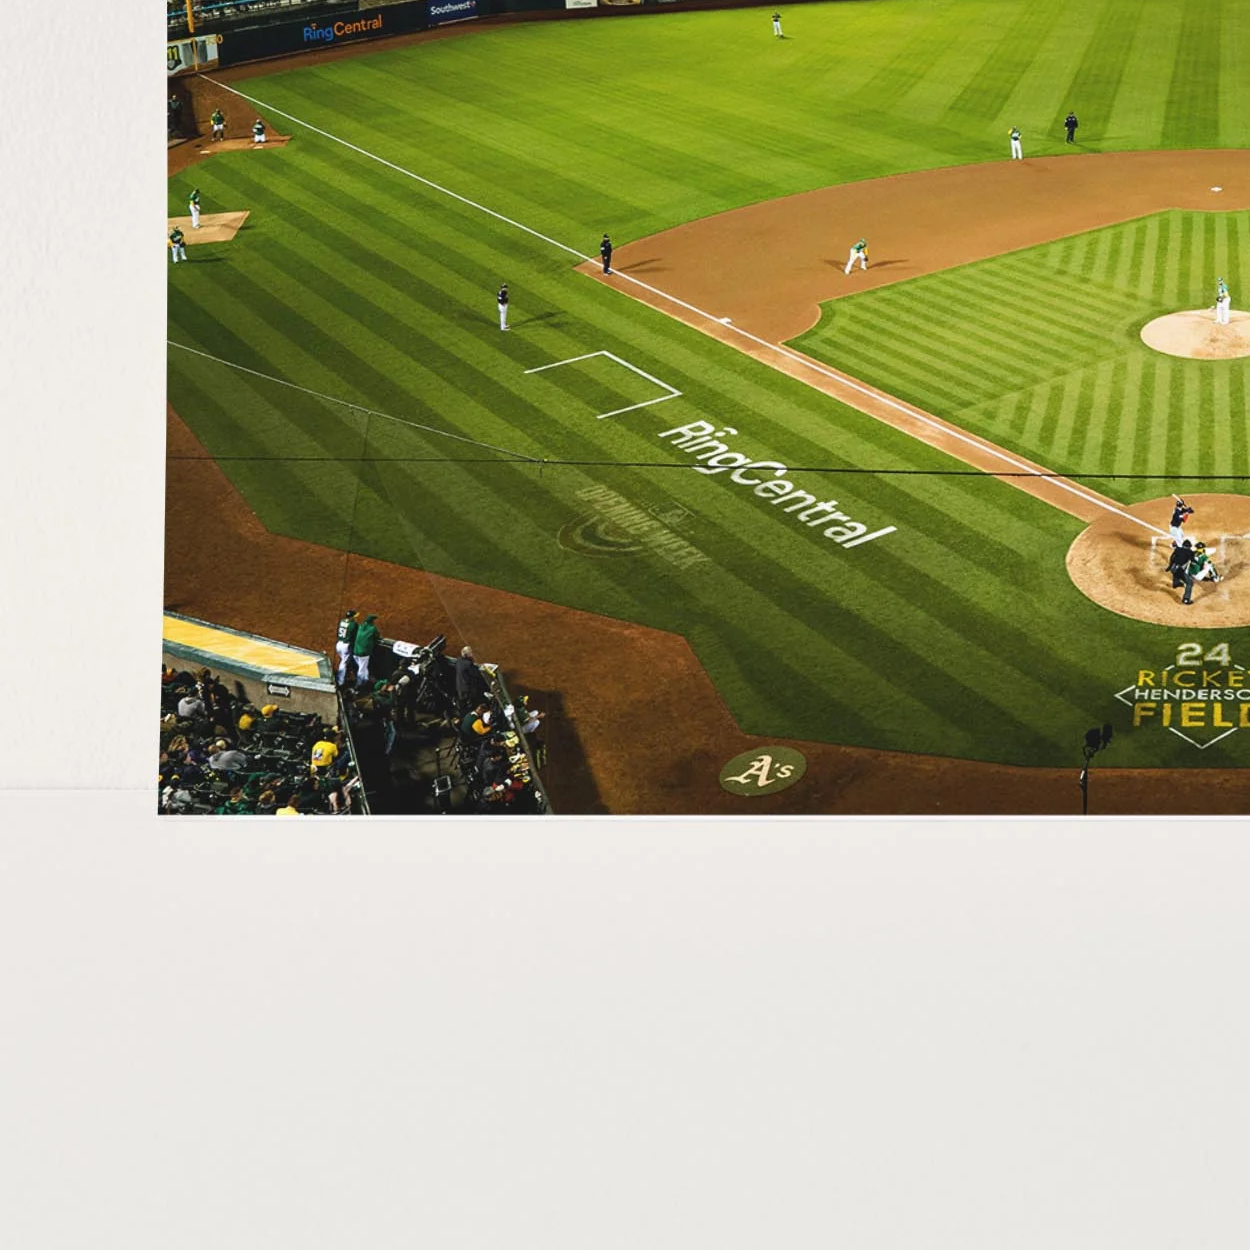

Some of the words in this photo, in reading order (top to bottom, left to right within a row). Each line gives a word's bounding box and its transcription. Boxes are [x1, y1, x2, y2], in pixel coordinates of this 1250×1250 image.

[430, 0, 471, 15] Southwest
[304, 15, 383, 42] RingCentral
[658, 420, 897, 549] RingCentral
[1176, 642, 1232, 667] 24
[724, 754, 794, 787] A's
